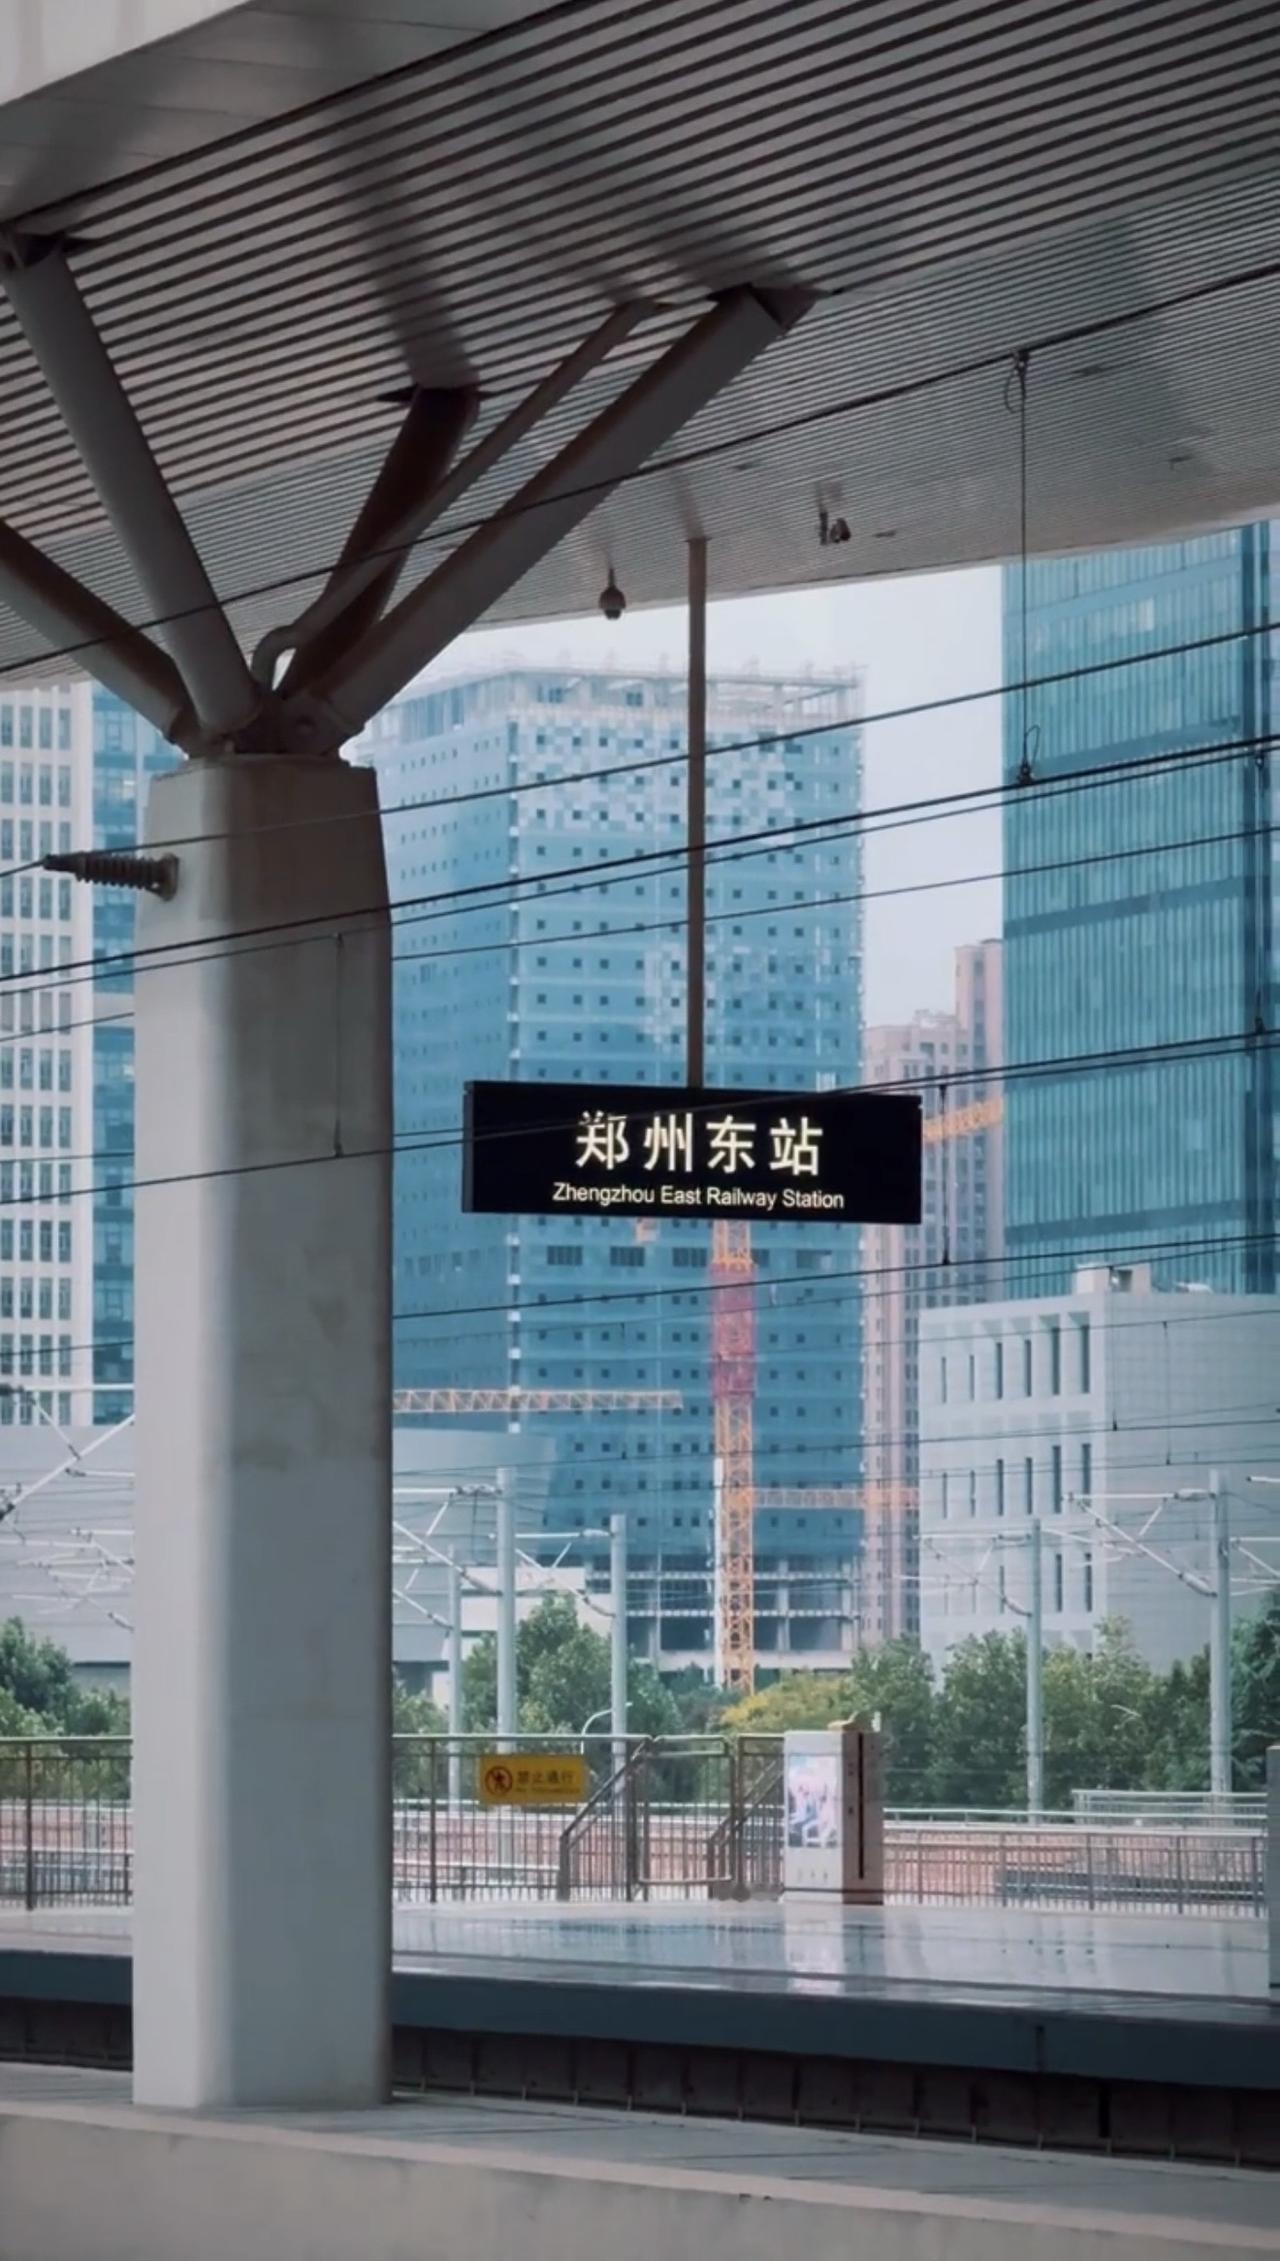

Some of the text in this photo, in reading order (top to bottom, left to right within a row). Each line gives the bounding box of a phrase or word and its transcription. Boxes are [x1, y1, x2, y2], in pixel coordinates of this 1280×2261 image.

[575, 1110, 824, 1176] 郑州东站
[552, 1181, 844, 1211] Zhengzhou East Railway Station
